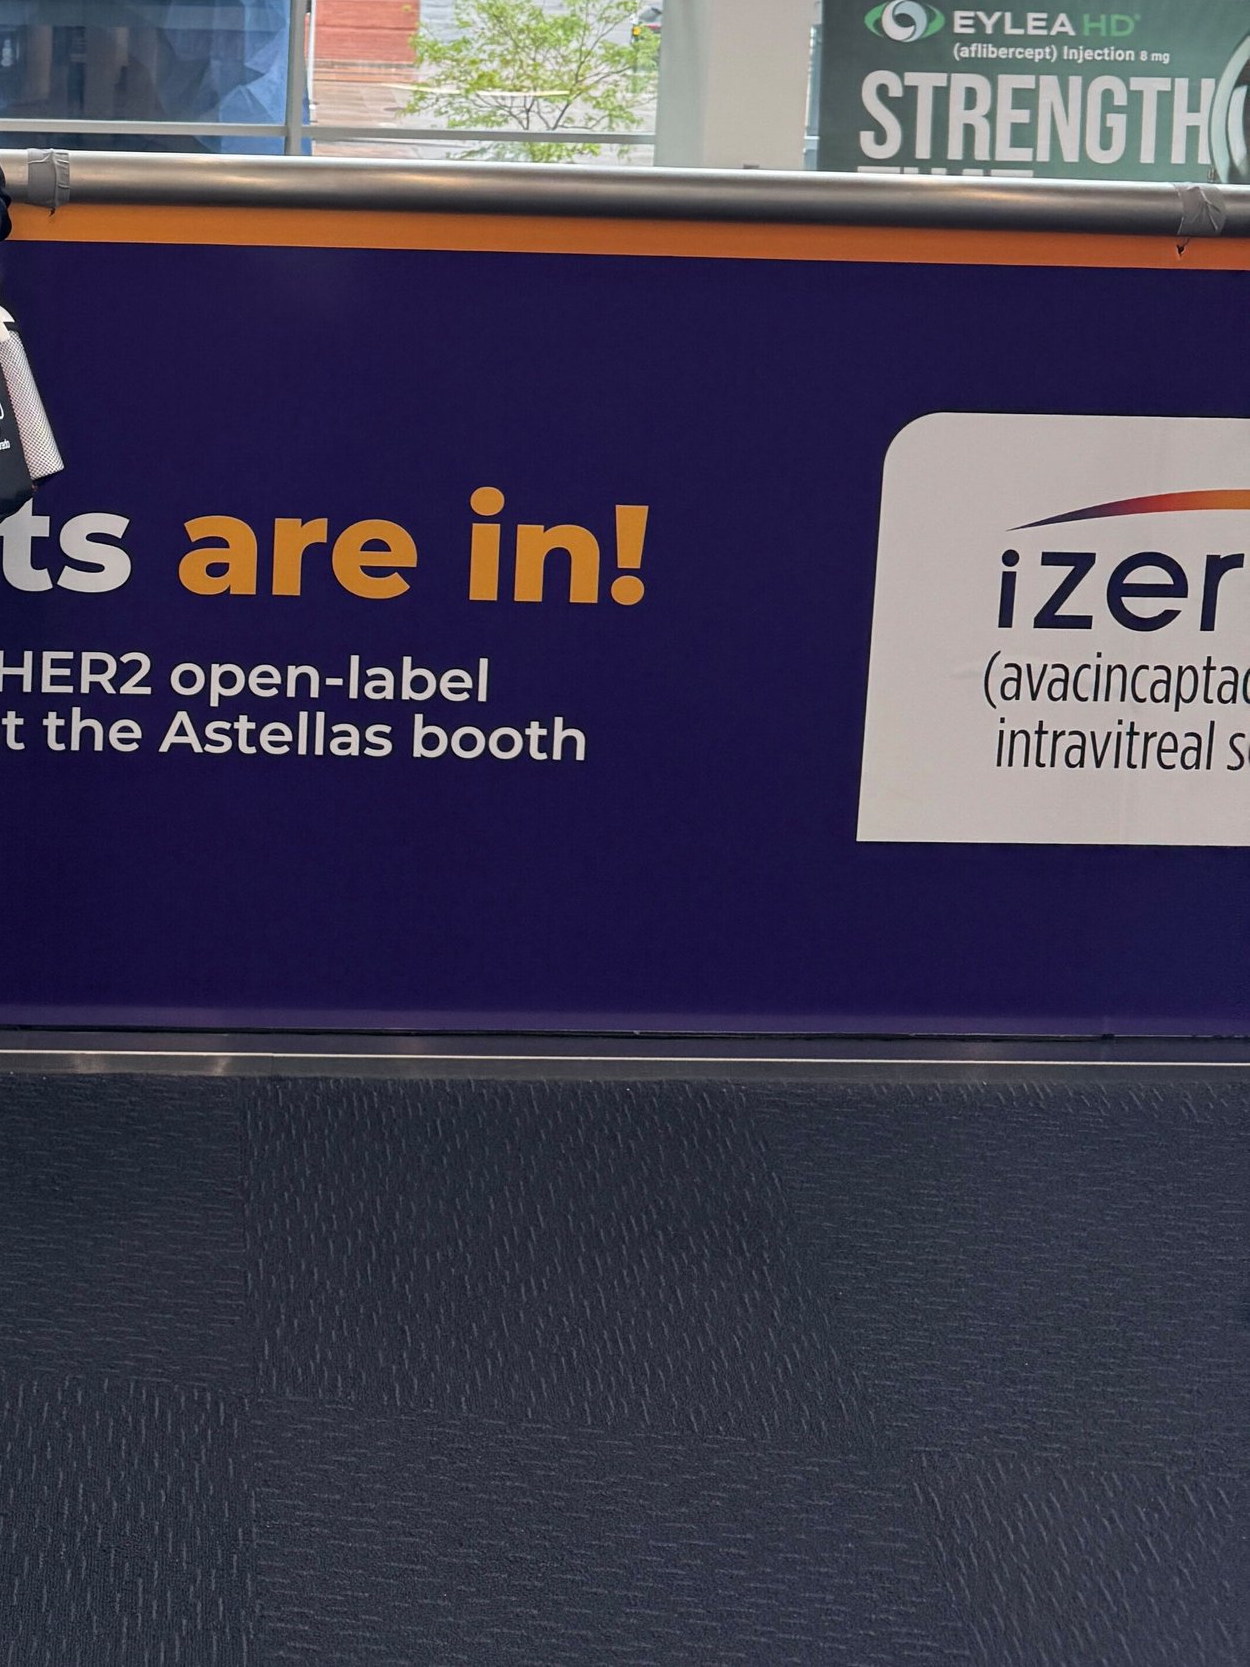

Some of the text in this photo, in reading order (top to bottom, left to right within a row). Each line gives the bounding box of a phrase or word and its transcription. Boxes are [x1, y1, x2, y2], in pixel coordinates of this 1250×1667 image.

[953, 10, 1076, 36] EYLEA
[953, 42, 1170, 65] (aflibercept) Injection 8 mg
[859, 69, 1216, 165] STRENGTH
[178, 515, 418, 599] are
[469, 486, 649, 605] in!
[998, 549, 1245, 632] izer
[170, 654, 489, 707] open-label
[43, 707, 143, 752] the
[159, 711, 393, 757] Astellas
[412, 713, 586, 761] booth
[996, 717, 1215, 770] intravitreal
